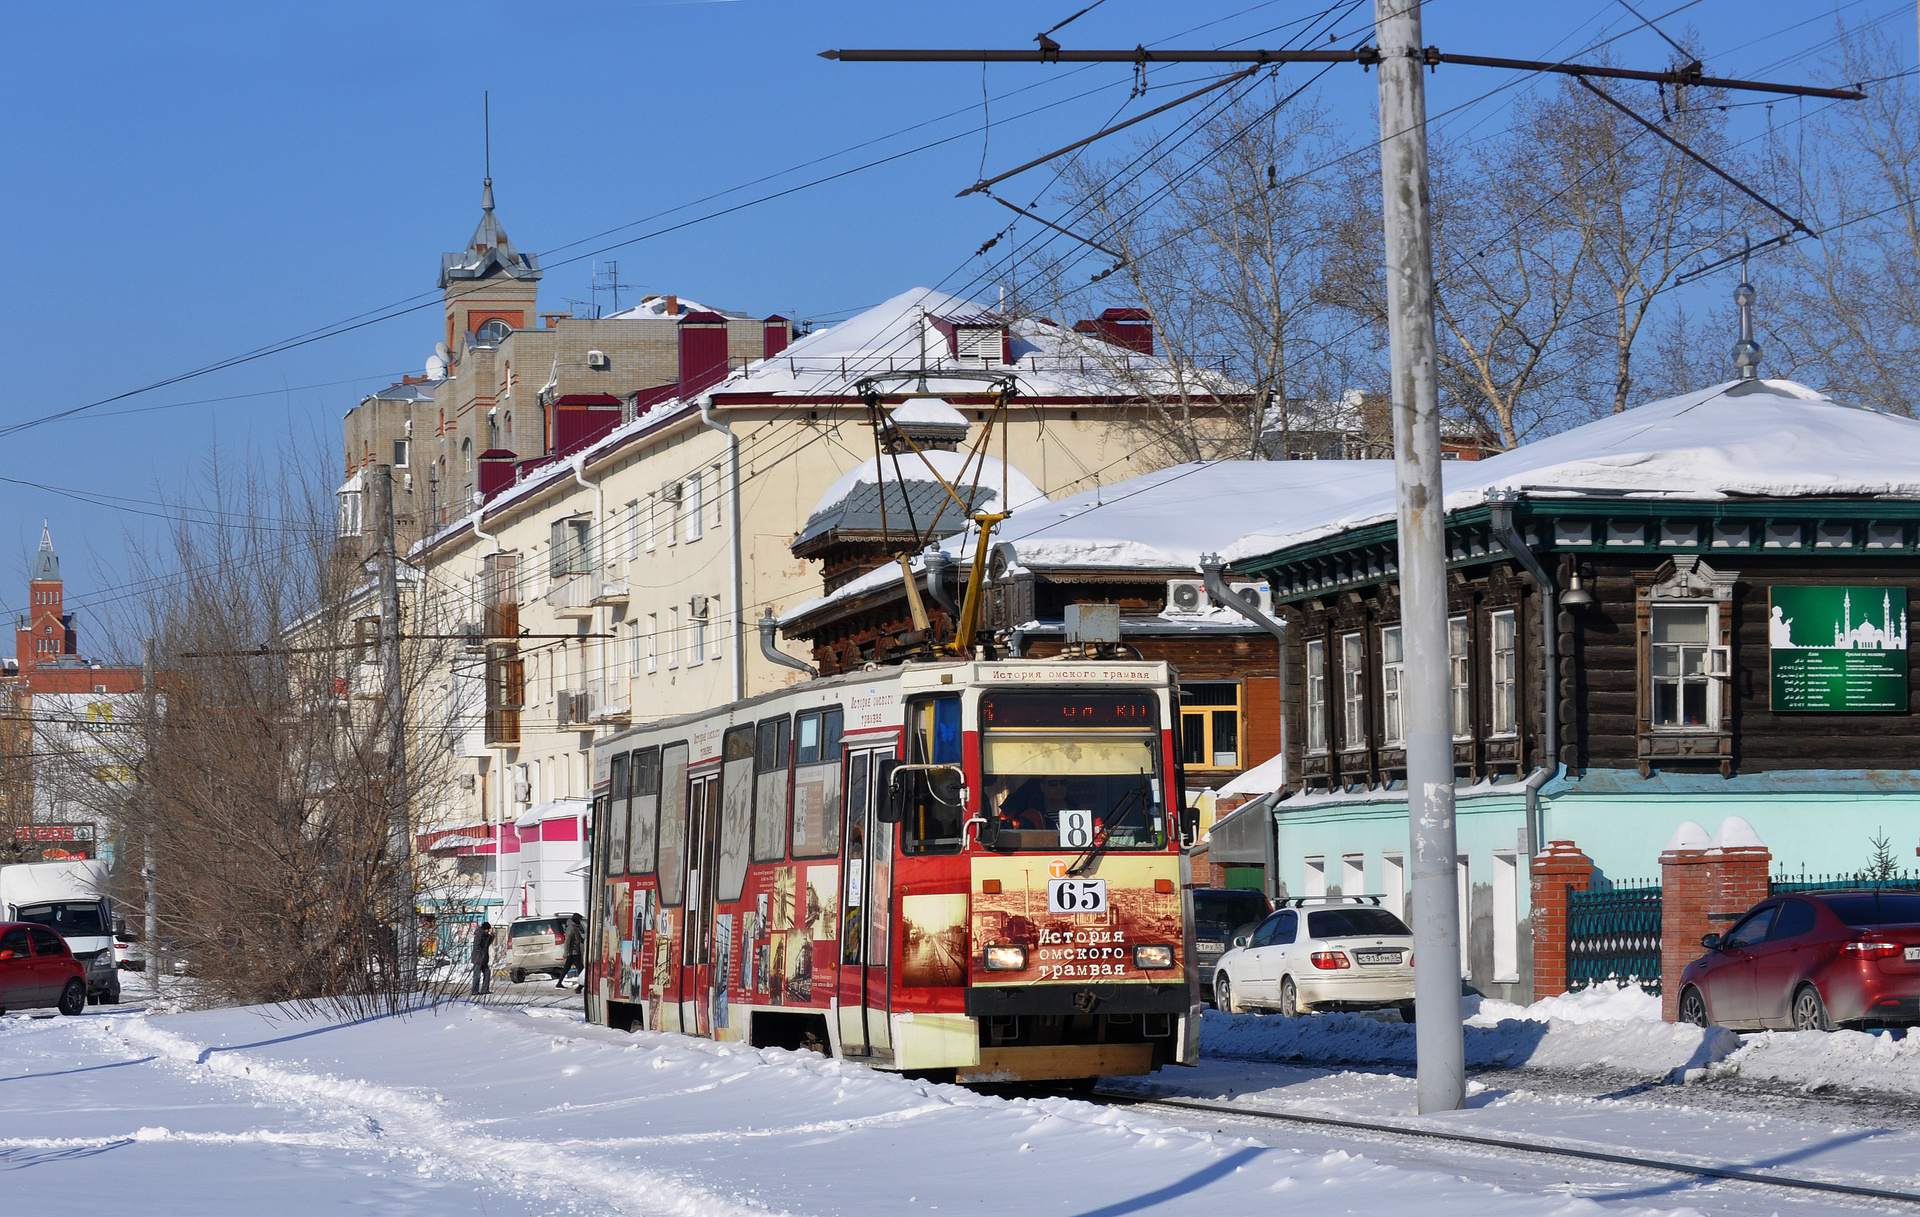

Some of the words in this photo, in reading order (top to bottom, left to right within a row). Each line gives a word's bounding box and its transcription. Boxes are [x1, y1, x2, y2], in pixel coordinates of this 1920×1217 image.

[993, 670, 1042, 680] История
[1048, 670, 1096, 679] омского
[1102, 671, 1150, 680] трамвая
[1067, 813, 1087, 847] 8
[1056, 882, 1101, 910] 65
[1038, 928, 1125, 945] История
[1039, 947, 1124, 960] омского
[1039, 963, 1126, 979] трамвая
